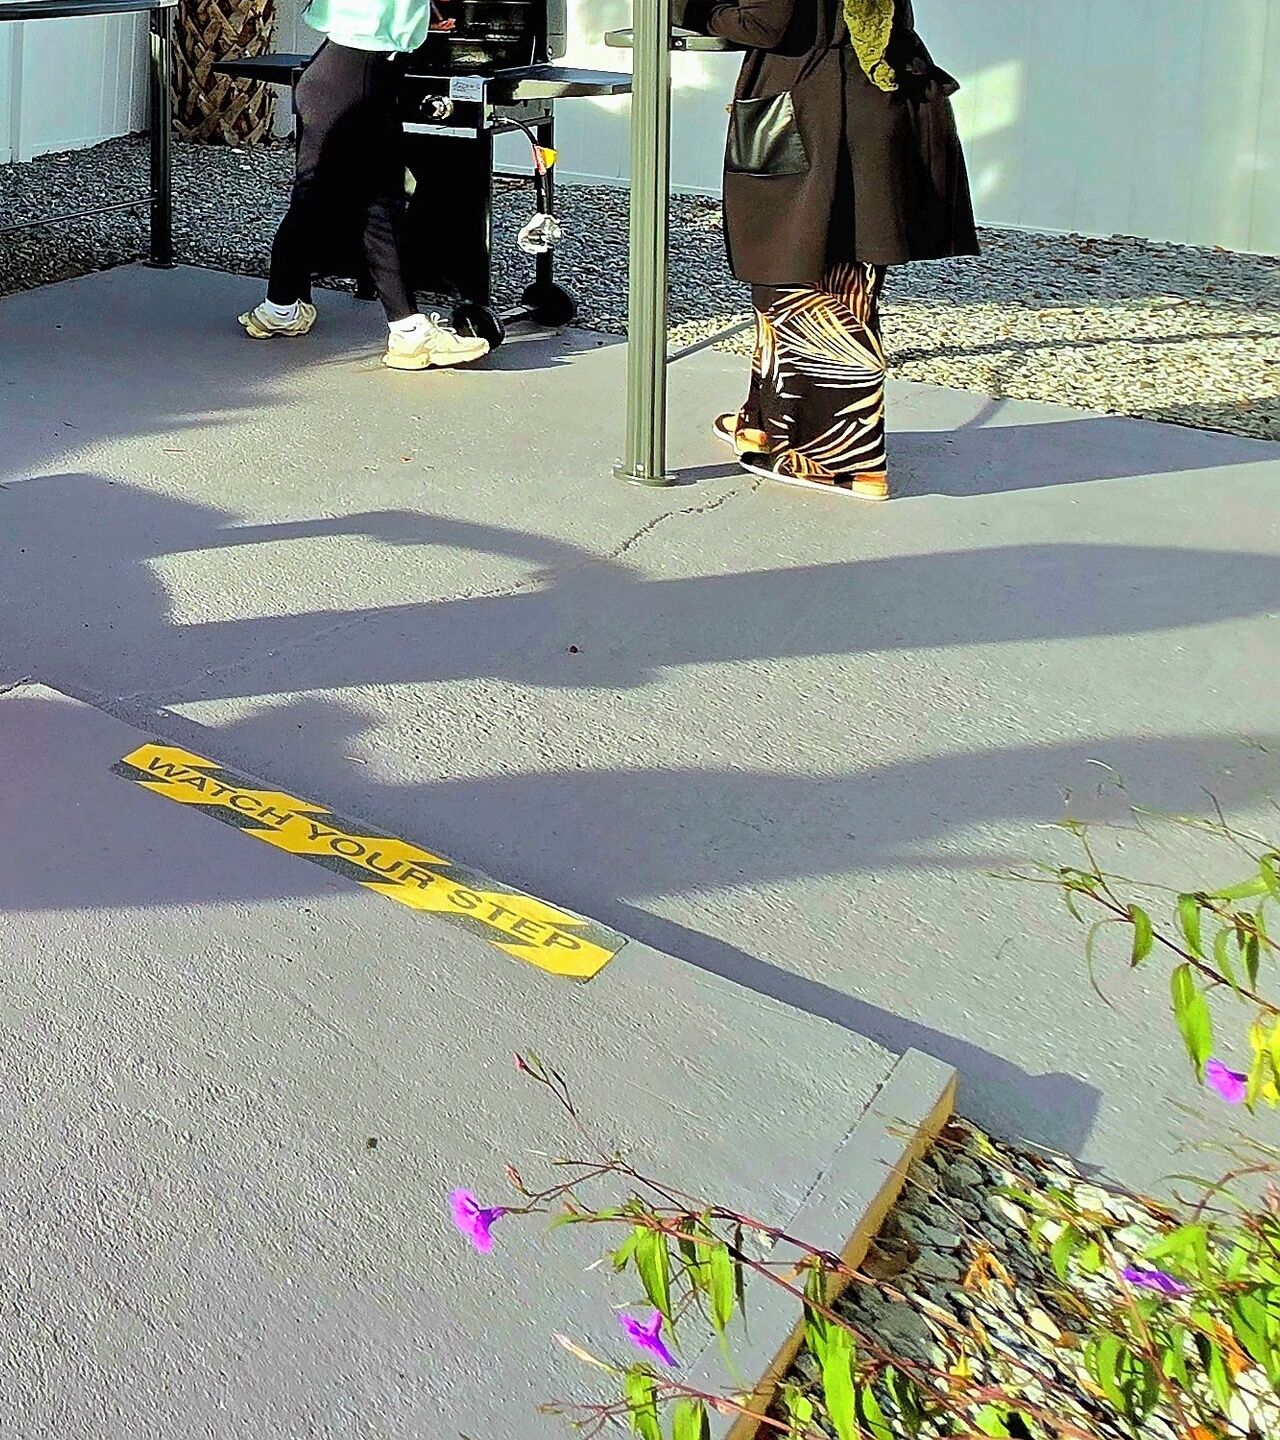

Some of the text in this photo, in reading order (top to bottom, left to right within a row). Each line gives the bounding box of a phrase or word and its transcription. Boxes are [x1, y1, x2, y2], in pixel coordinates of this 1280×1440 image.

[146, 755, 582, 955] WATCH YOUR STEP
